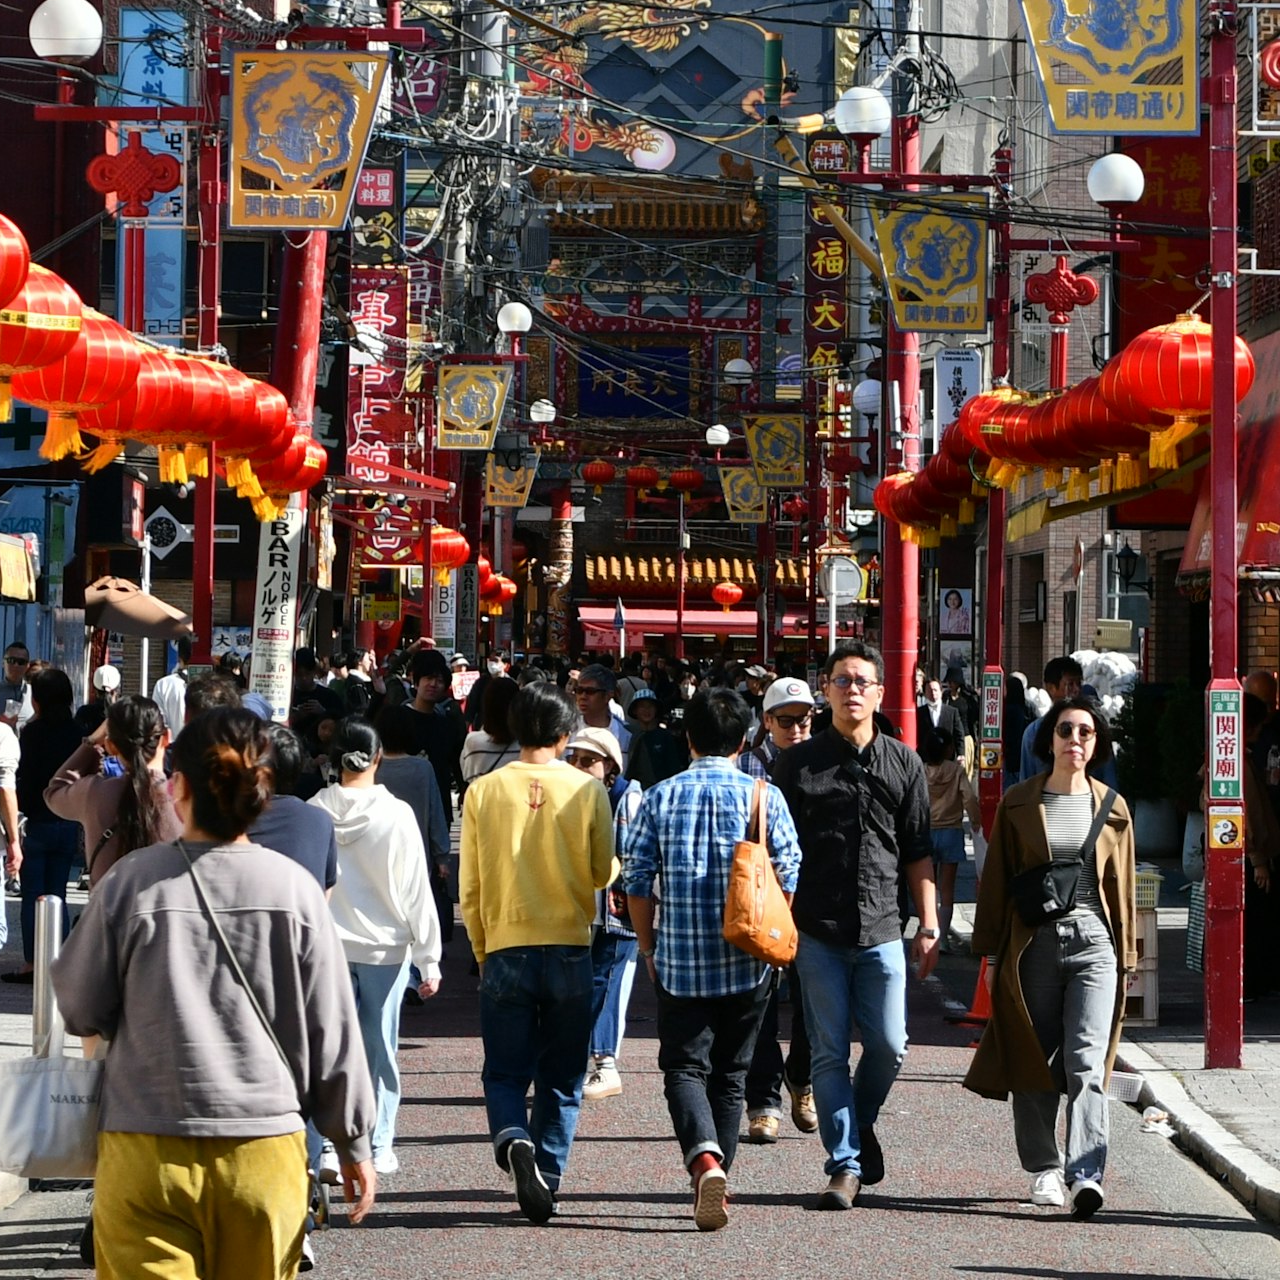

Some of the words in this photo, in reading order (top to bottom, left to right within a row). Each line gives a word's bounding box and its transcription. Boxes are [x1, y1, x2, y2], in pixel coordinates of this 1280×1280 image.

[1066, 89, 1185, 122] 関帝廟通り
[361, 172, 391, 187] 中国
[361, 189, 391, 202] 料理
[904, 304, 978, 325] 関帝廟通り
[267, 521, 291, 569] BAR
[261, 570, 278, 625] ノルゲ
[1215, 714, 1238, 779] 関帝廟
